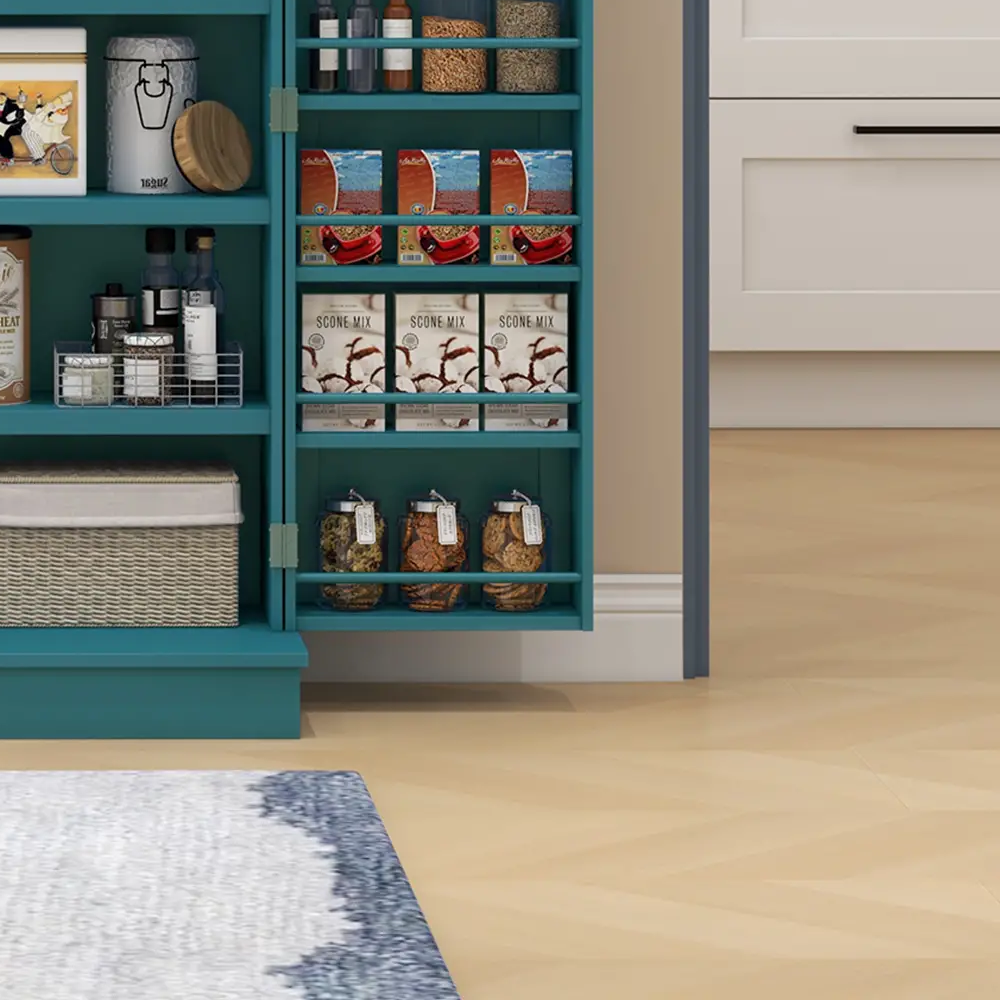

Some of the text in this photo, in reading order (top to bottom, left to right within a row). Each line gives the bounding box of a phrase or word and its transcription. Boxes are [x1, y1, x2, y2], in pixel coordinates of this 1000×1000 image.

[316, 316, 371, 329] SCONE MIX
[410, 316, 465, 329] SCONE MIX
[499, 315, 554, 328] SCONE MIX
